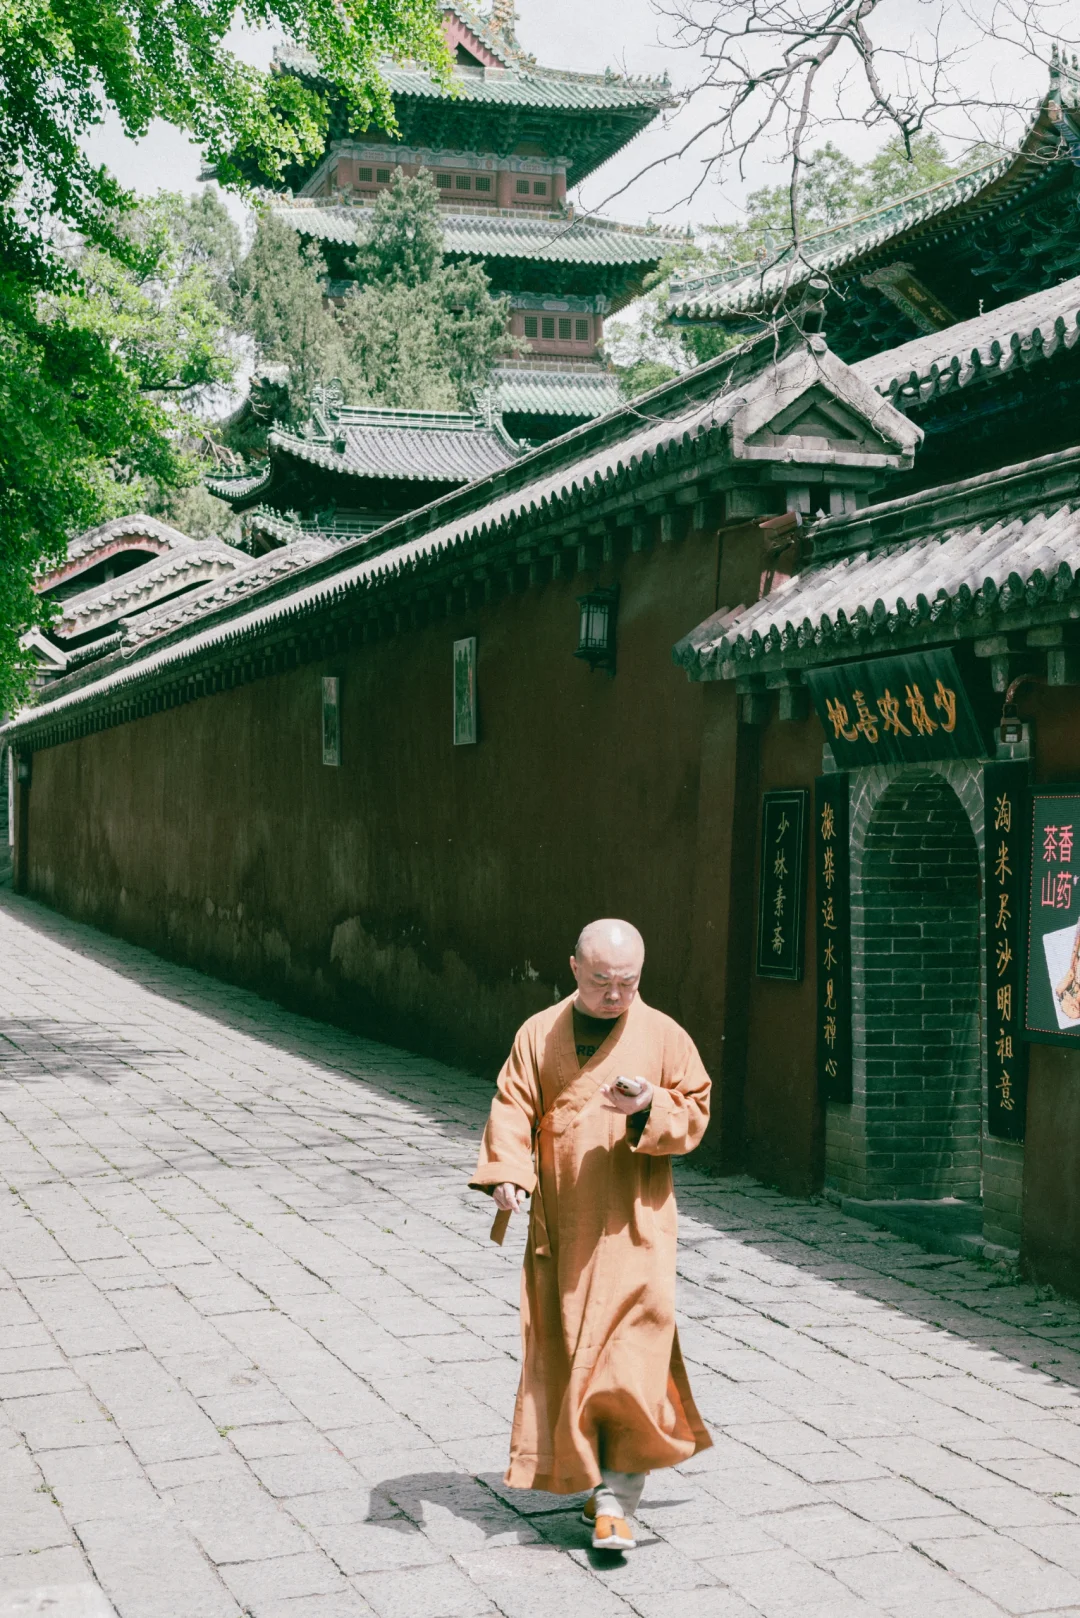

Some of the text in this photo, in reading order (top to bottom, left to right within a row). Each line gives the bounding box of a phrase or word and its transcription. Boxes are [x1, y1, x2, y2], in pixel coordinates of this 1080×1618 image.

[826, 678, 957, 743] 少林欢喜地
[771, 811, 790, 955] 少林素斋
[821, 802, 838, 1077] 搬柴运水见禅心
[993, 792, 1015, 1111] 淘米尽沙明祖意
